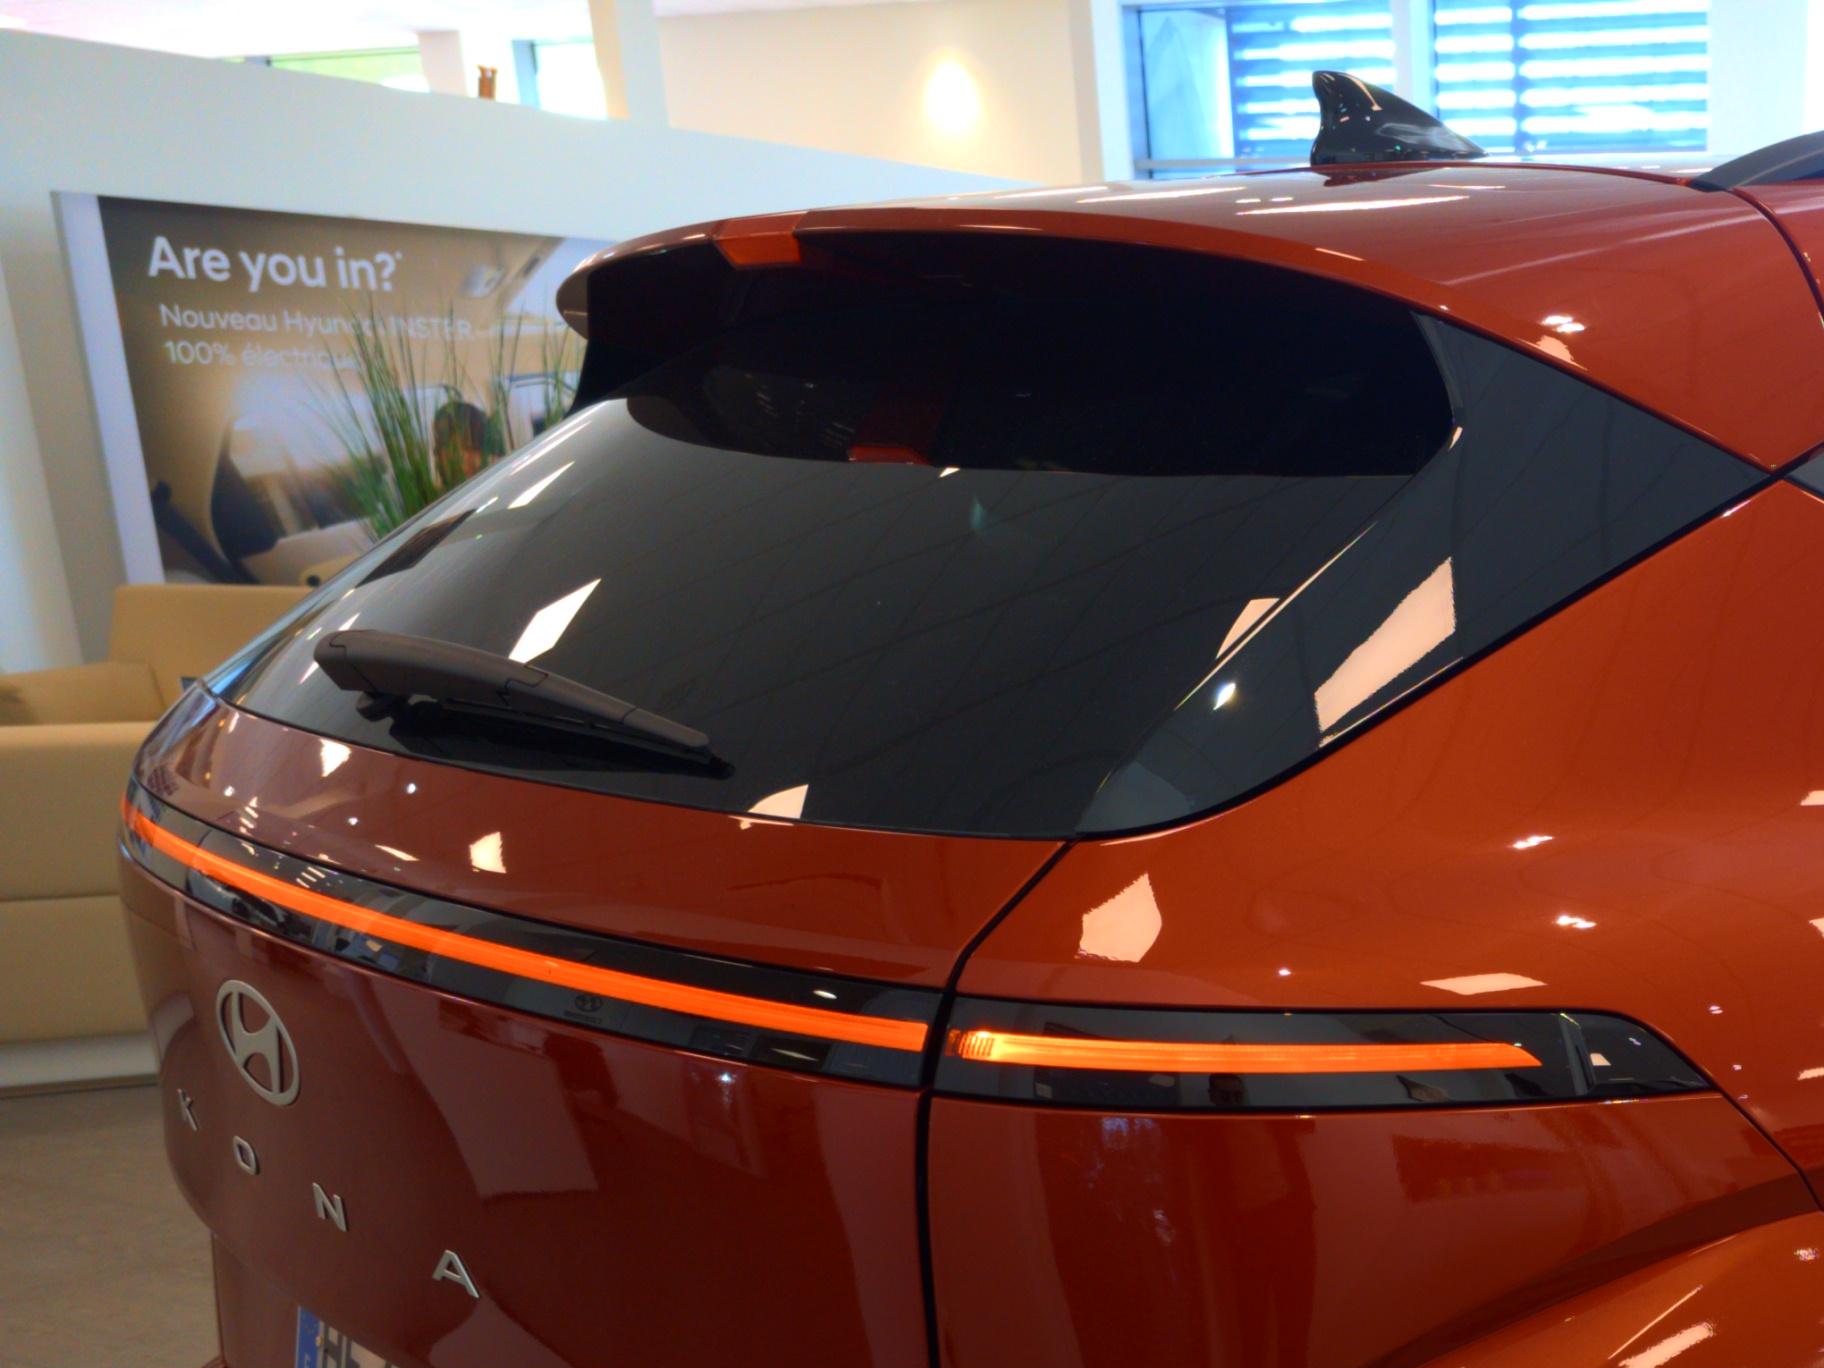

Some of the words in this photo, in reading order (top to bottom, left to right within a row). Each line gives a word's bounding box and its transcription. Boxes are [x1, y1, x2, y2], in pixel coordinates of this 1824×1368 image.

[148, 235, 231, 282] Are
[239, 251, 327, 293] you
[159, 303, 277, 332] Nouveau
[164, 340, 238, 367] 100%
